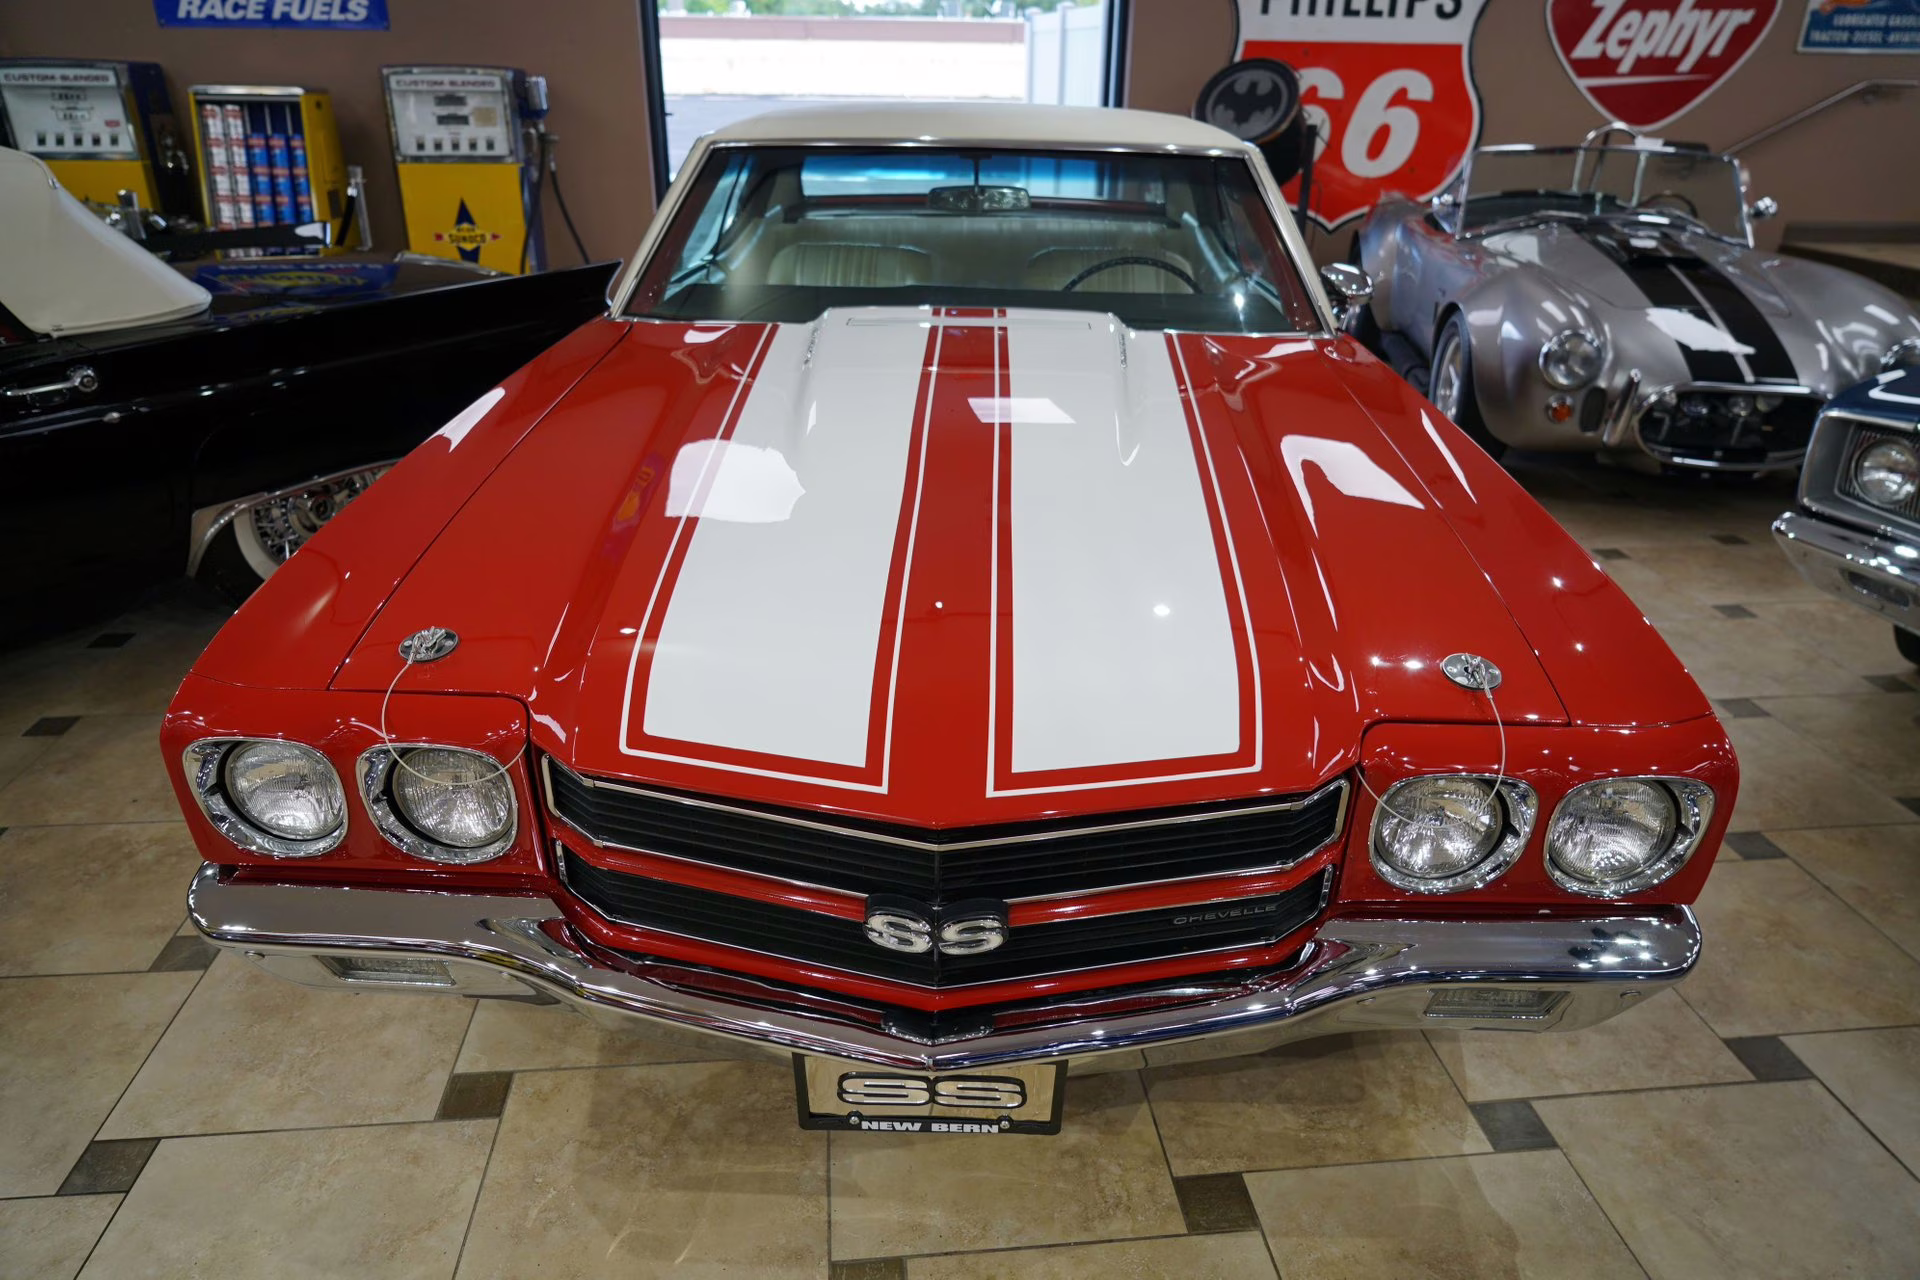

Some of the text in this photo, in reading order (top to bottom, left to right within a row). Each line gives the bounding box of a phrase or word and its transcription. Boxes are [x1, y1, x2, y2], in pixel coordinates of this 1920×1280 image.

[177, 0, 369, 21] RACE FUELS
[1569, 0, 1757, 75] Zephyr
[448, 233, 487, 244] SUNOCO
[1173, 905, 1277, 925] CHEVELLE
[865, 911, 1004, 956] SS
[837, 1071, 1027, 1109] SS
[861, 1120, 999, 1134] NEW BERN
